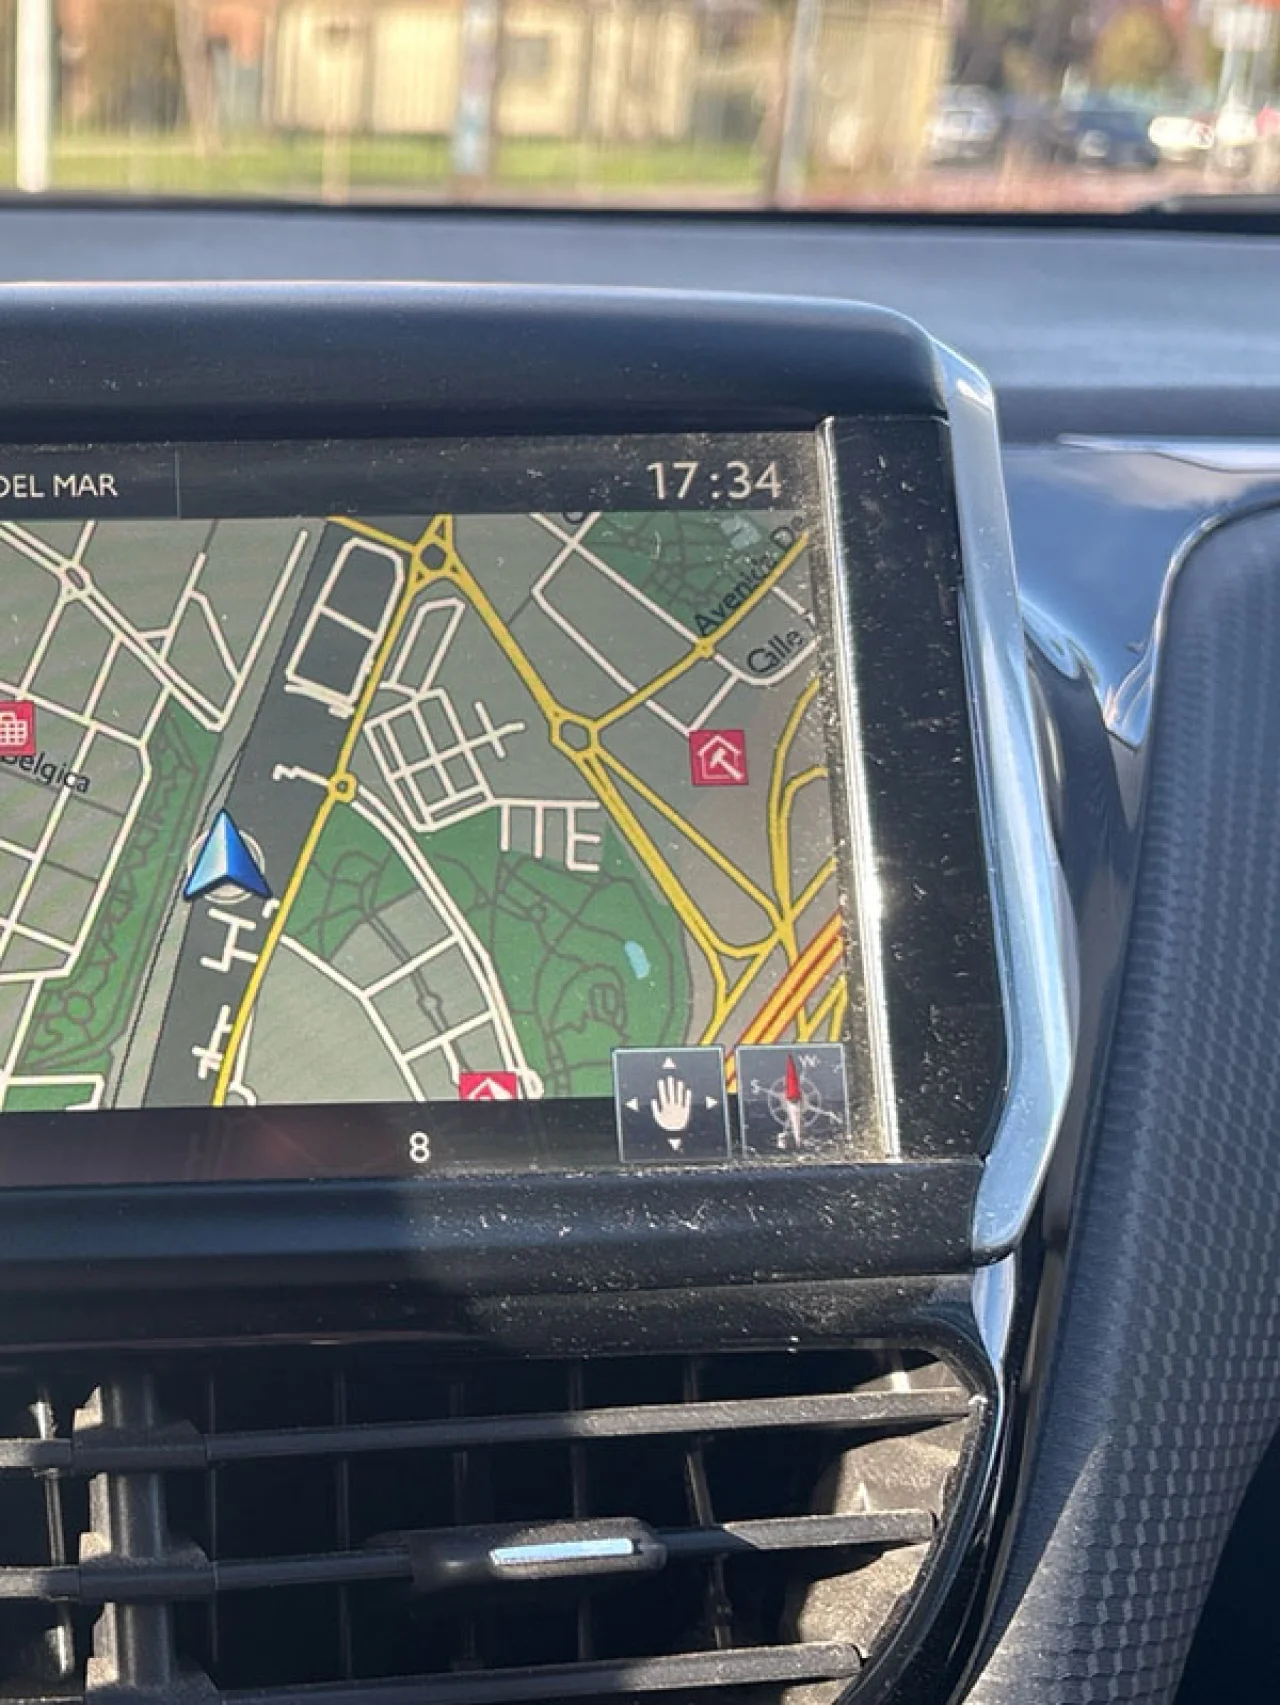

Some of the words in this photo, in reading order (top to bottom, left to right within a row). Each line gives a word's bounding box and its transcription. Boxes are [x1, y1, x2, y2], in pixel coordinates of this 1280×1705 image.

[52, 473, 119, 498] MAR
[646, 460, 784, 500] 17:34
[408, 1131, 431, 1163] 8
